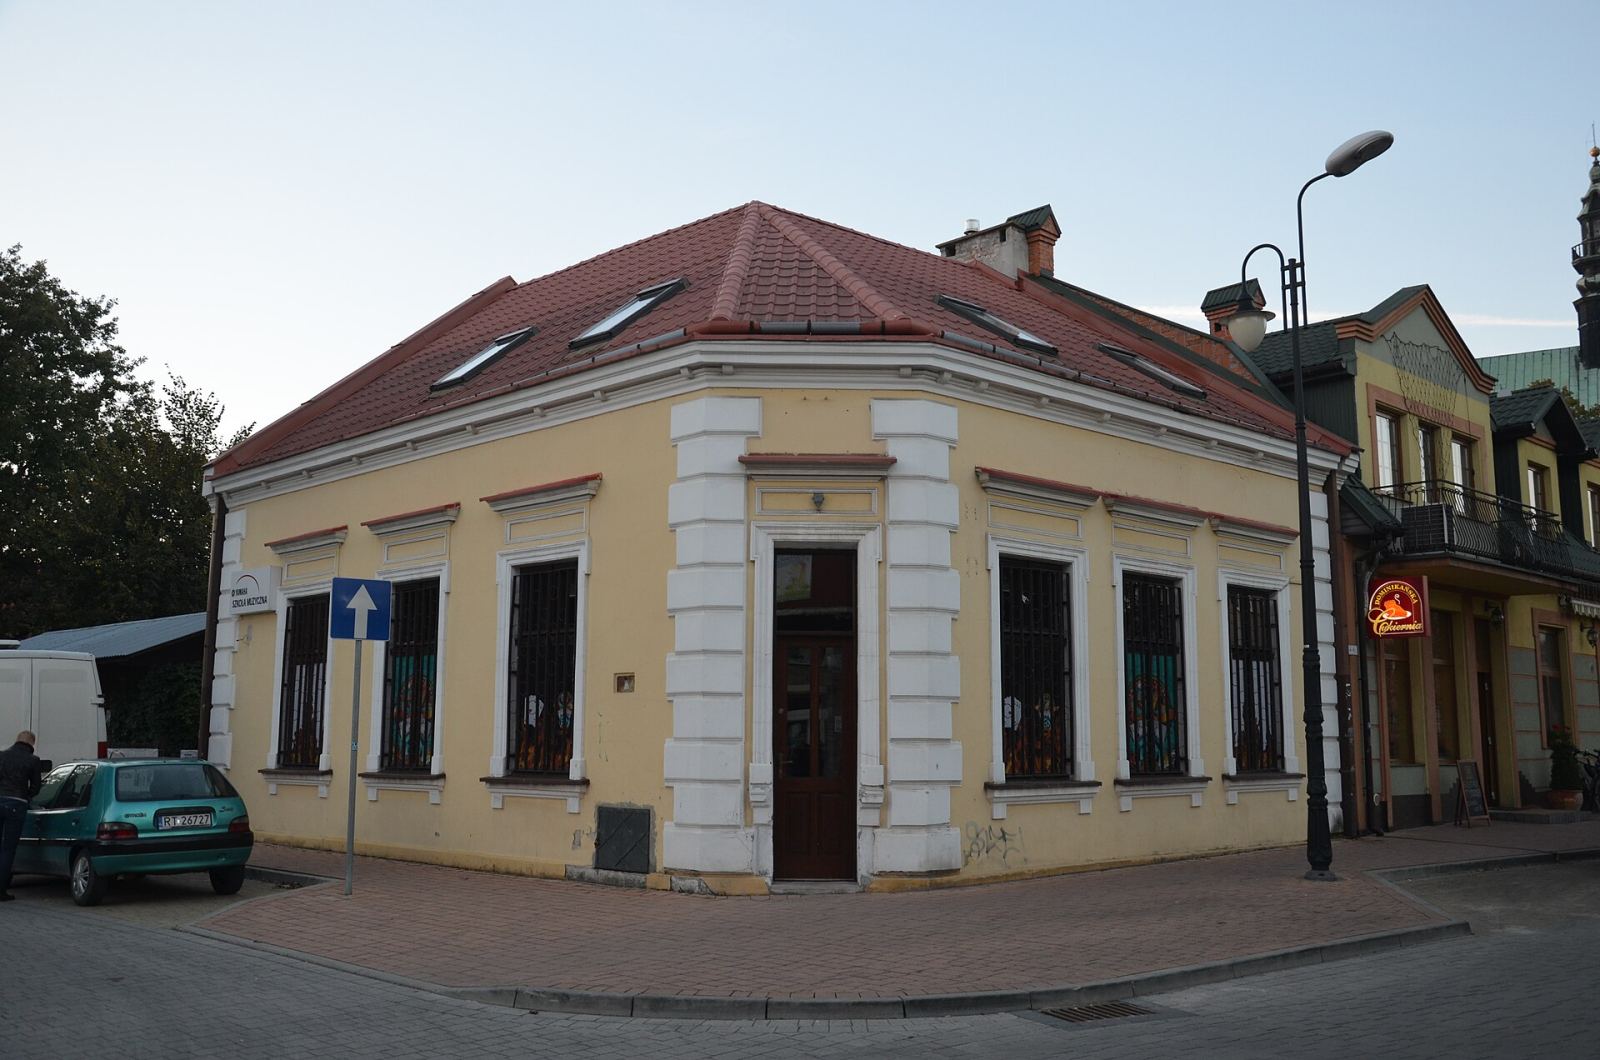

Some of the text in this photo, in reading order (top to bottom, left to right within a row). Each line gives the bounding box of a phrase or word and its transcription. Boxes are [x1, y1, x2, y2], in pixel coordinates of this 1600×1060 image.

[1368, 607, 1423, 637] Cukiernia
[163, 814, 210, 827] RT 26727
